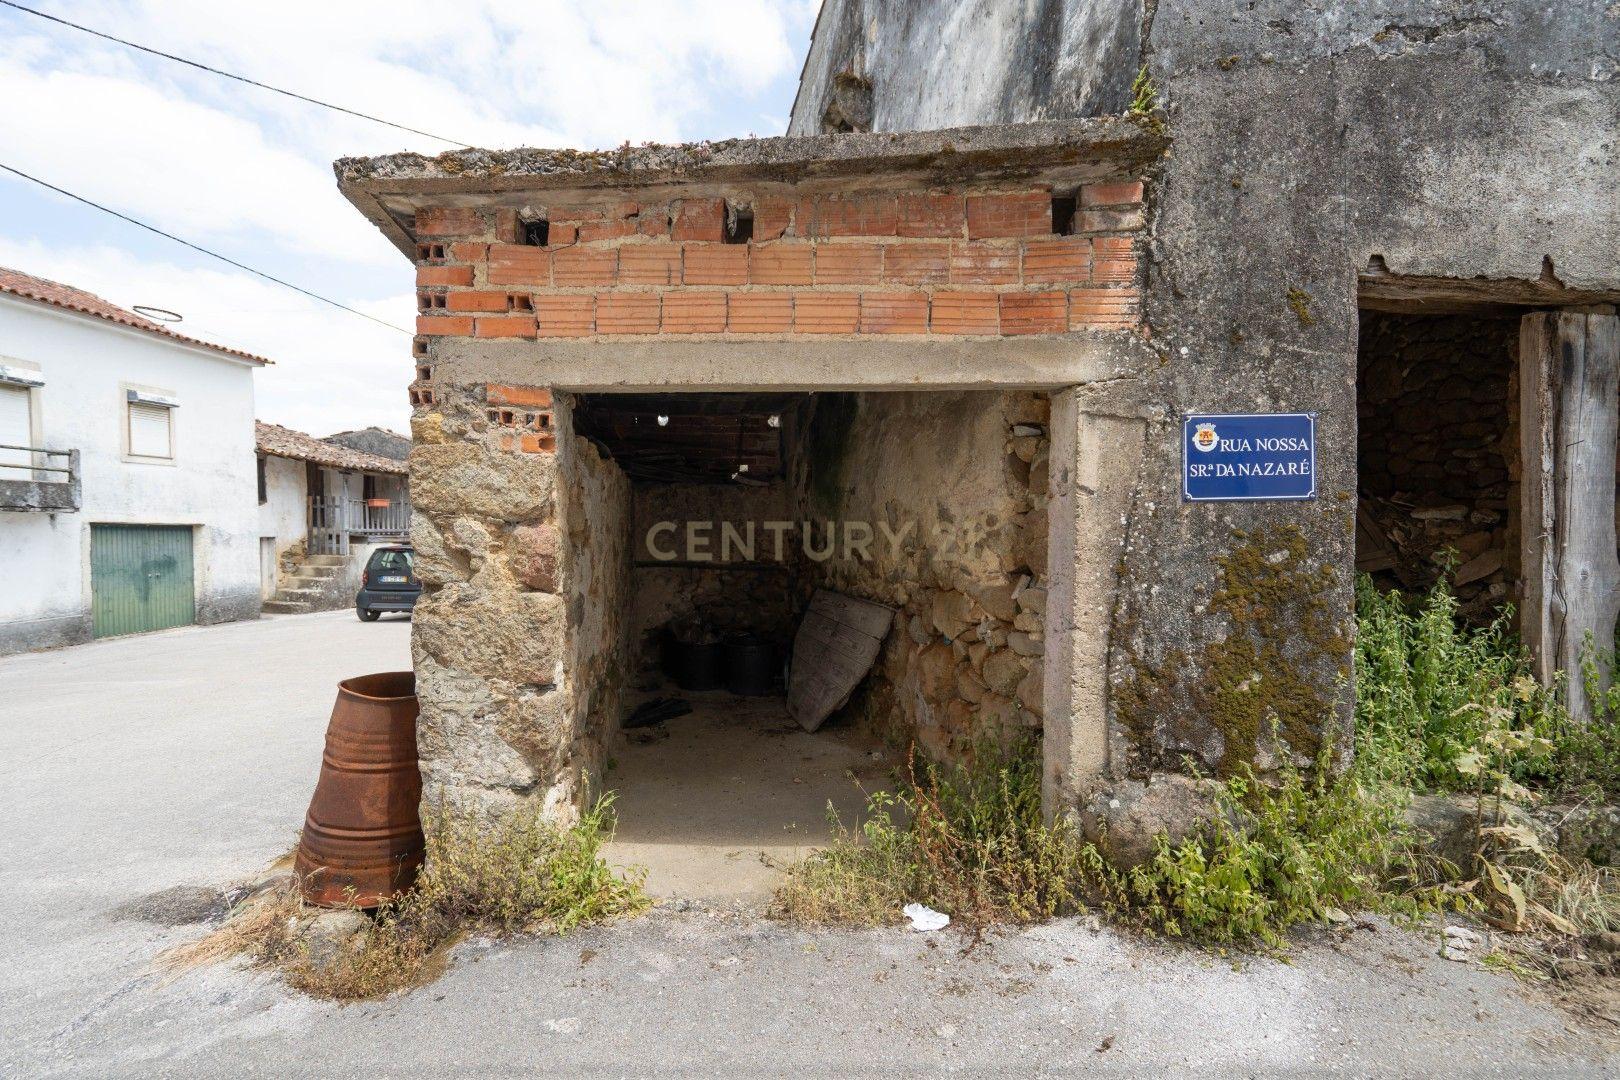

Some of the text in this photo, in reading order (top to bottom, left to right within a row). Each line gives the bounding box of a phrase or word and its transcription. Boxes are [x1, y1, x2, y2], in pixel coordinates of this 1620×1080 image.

[1220, 437, 1310, 452] RUA NOSSA
[1238, 458, 1310, 477] NAZARÉ
